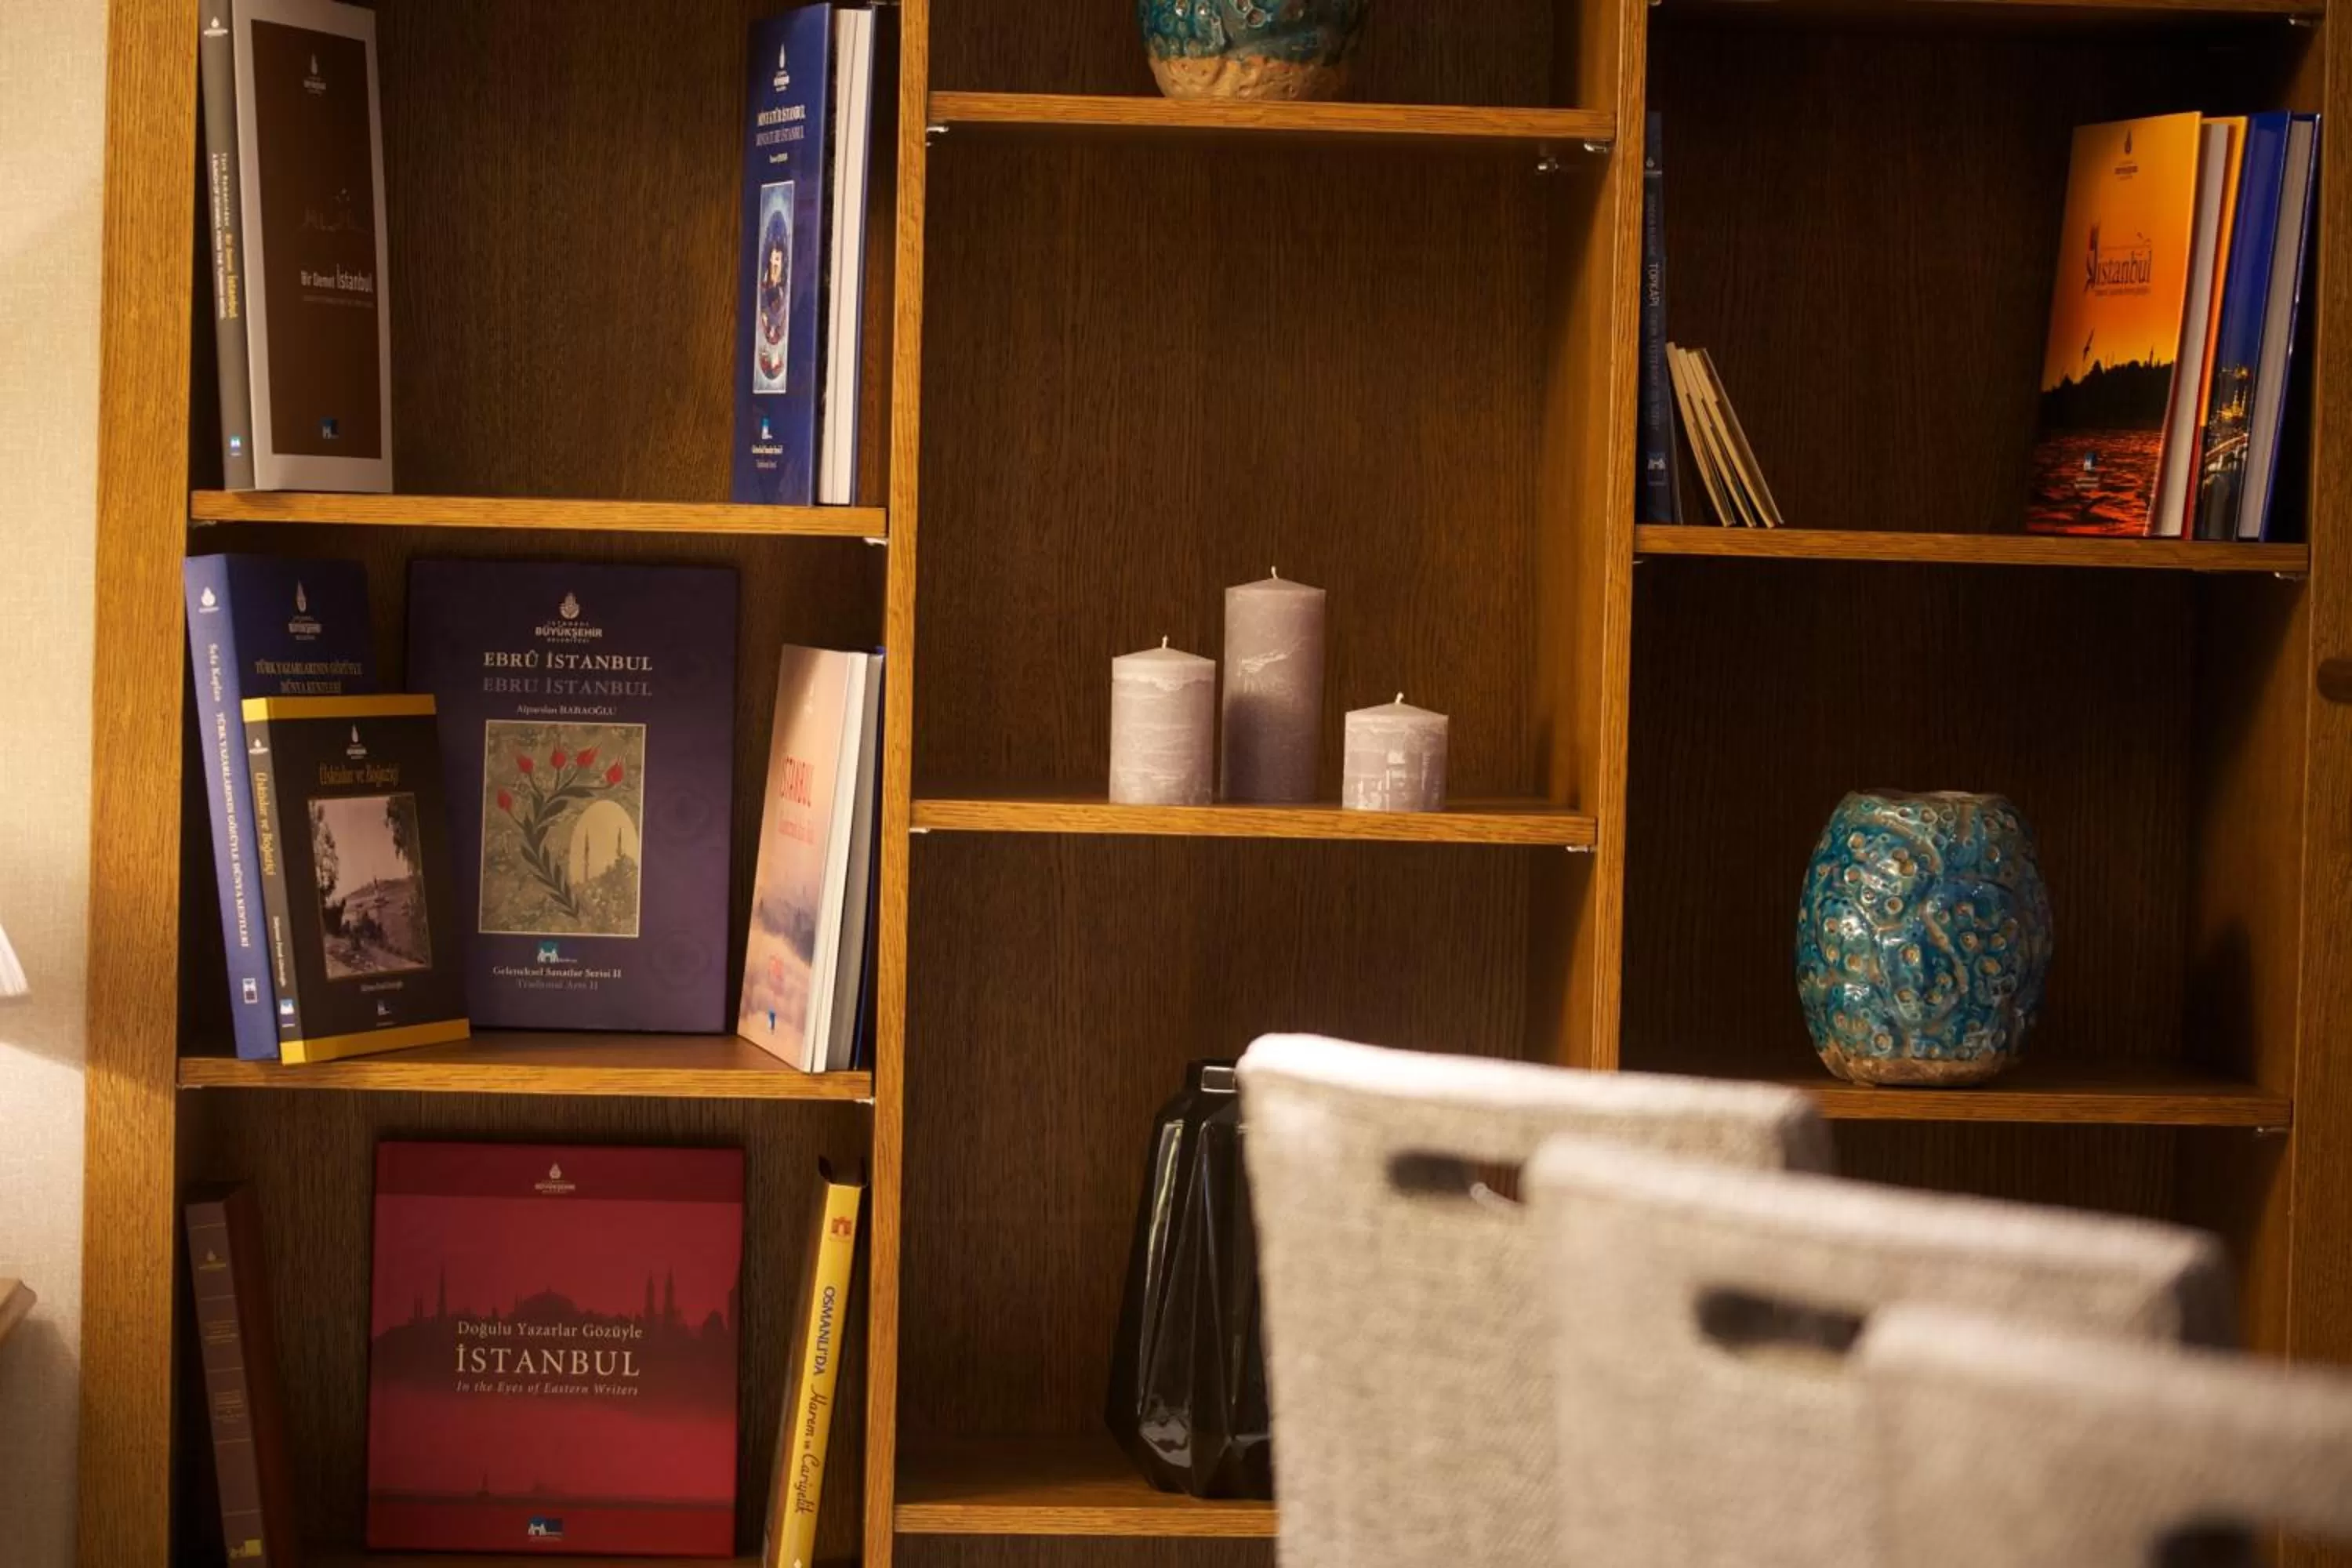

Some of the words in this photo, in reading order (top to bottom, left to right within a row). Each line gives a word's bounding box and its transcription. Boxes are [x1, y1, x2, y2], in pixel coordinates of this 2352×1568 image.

[535, 626, 603, 637] BÜYÜKŞEHİR
[483, 649, 539, 667] EBRÛ
[546, 651, 653, 671] İSTANBUL
[458, 1319, 511, 1339] Doğulu
[517, 1322, 578, 1338] Yazarlar
[583, 1323, 643, 1342] Gözüyle
[456, 1343, 641, 1377] İSTANBUL
